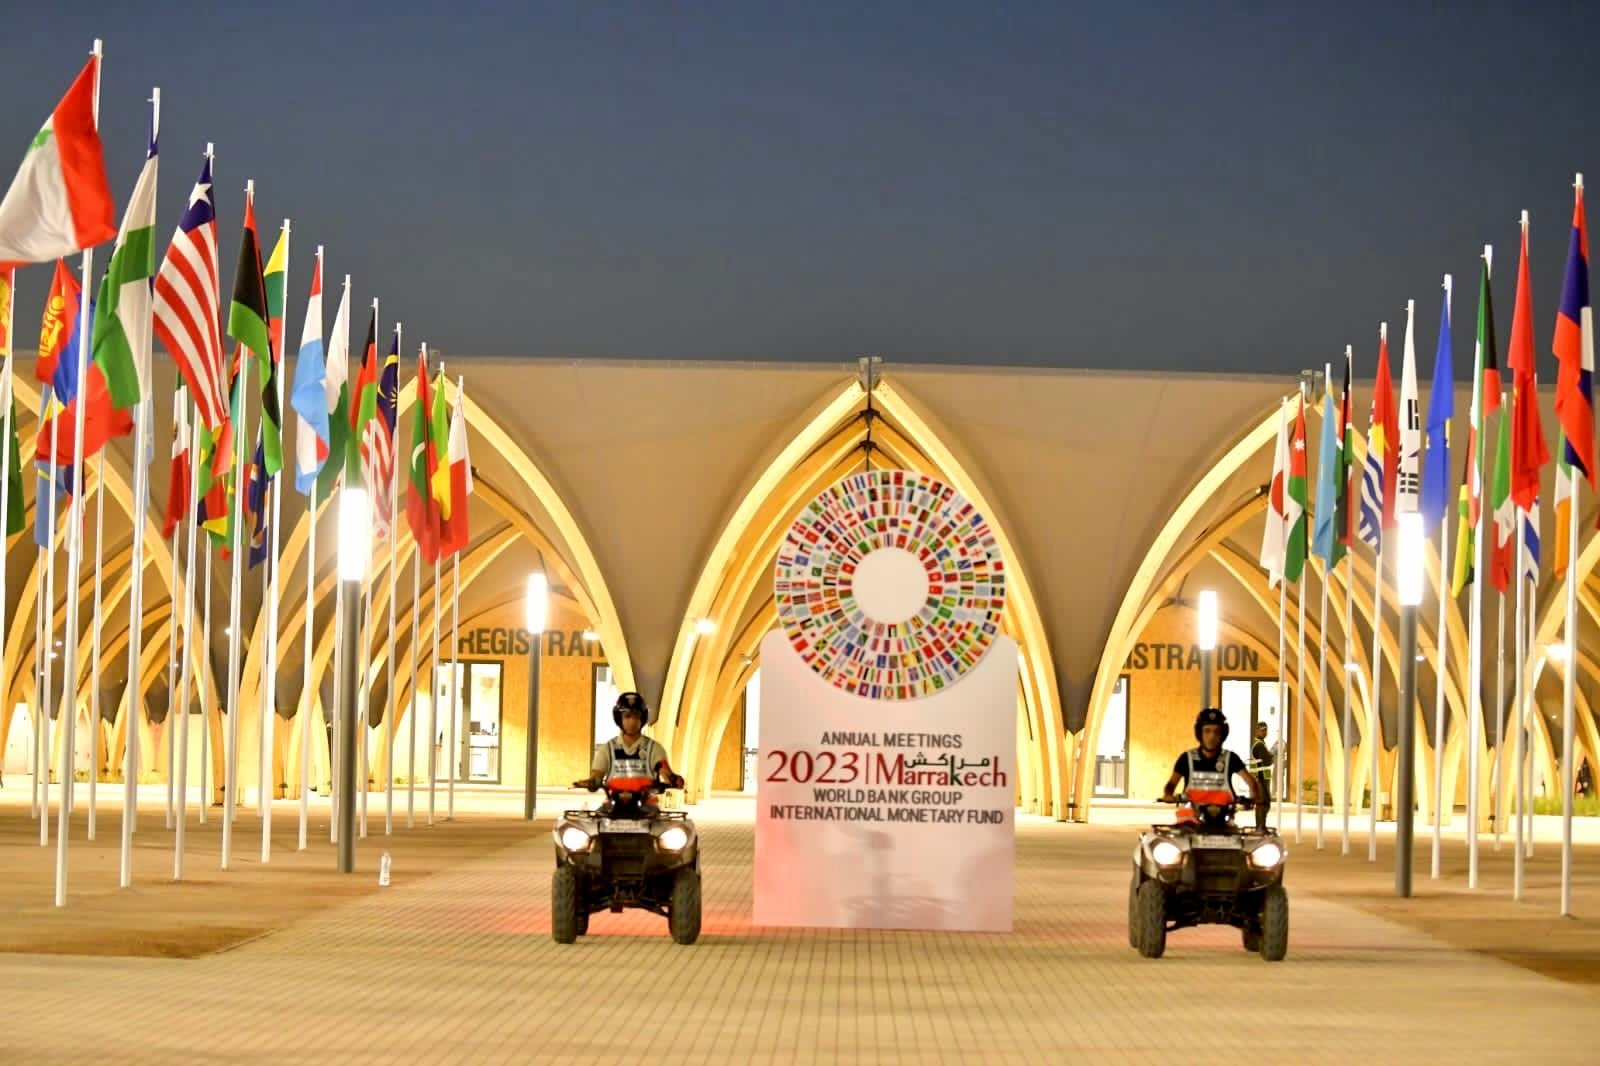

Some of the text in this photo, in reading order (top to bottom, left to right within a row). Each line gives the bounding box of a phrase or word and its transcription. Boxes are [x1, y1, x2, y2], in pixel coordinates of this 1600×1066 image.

[1122, 643, 1259, 671] ISTRAION
[820, 732, 962, 748] ANNUAL MEETINGS
[766, 750, 1007, 787] 2023 Marrakech
[904, 752, 990, 770] مراكش
[813, 788, 963, 805] WORLD BANK GROUP
[770, 804, 1004, 824] INTERNATIONAL MONETARY FUND
